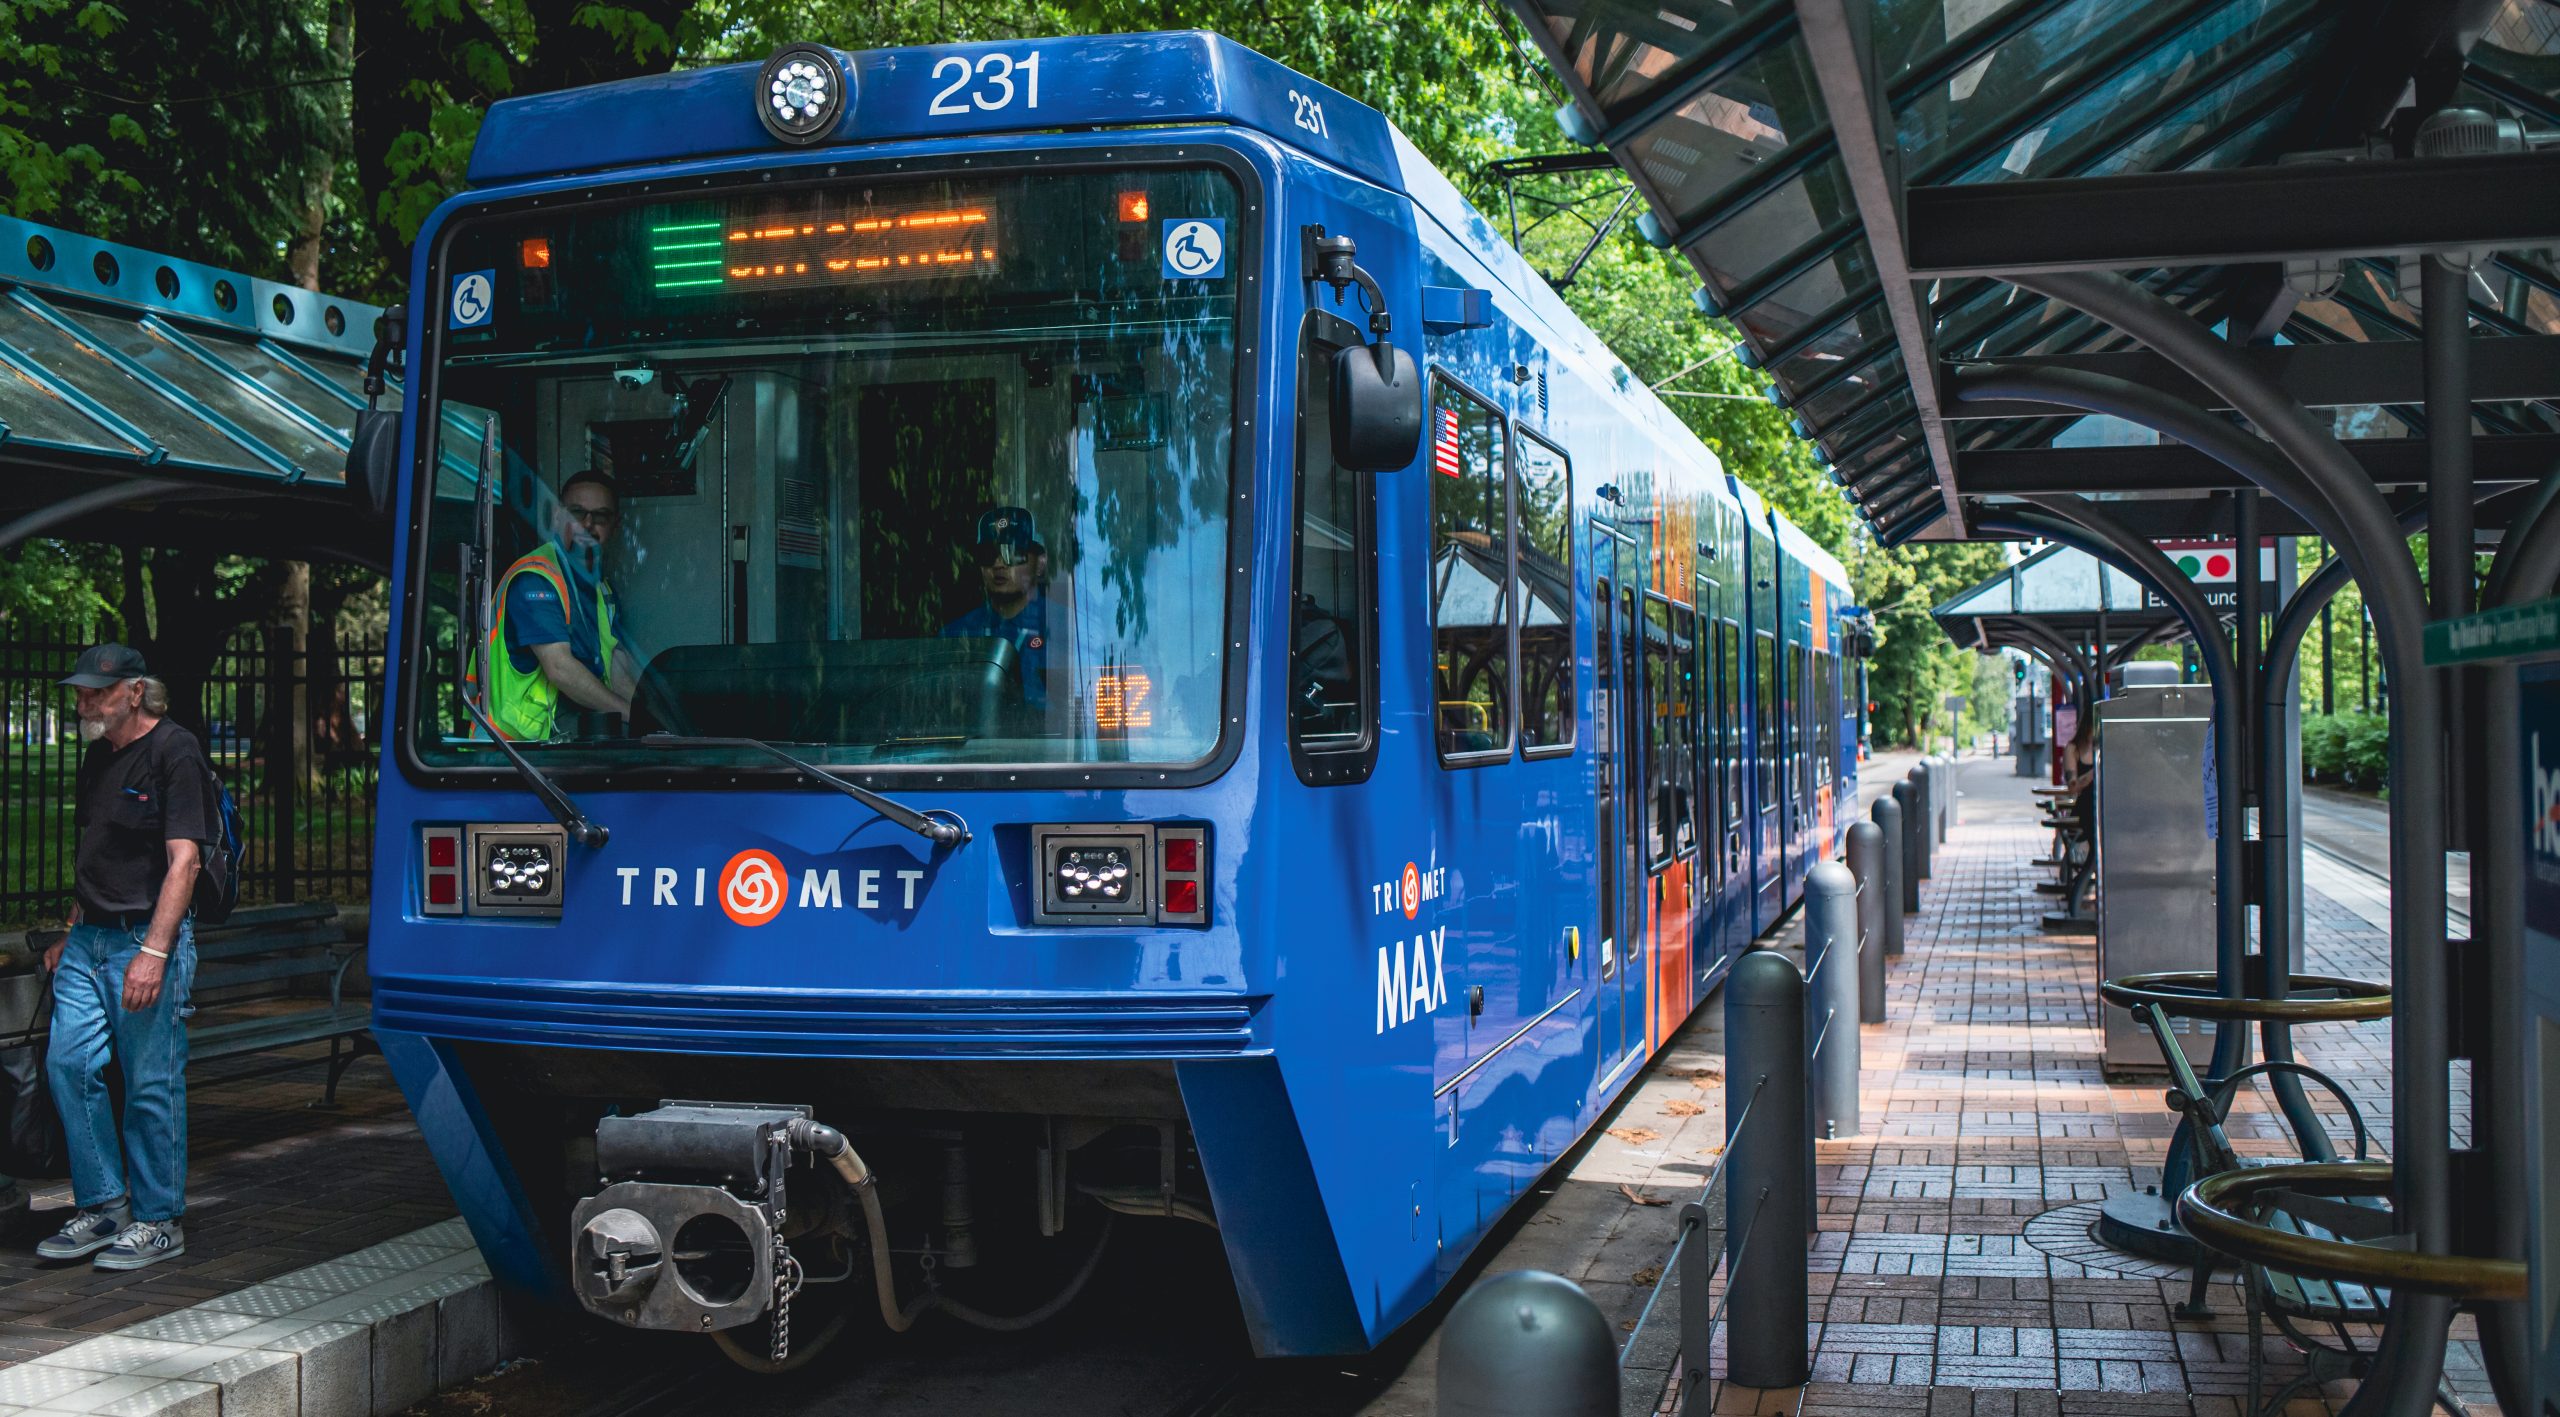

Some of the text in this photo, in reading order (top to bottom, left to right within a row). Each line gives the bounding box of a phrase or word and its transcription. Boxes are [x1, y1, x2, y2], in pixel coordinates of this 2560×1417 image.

[929, 51, 1040, 115] 231
[1288, 89, 1329, 139] 231
[616, 867, 924, 909] TRI MET
[1372, 866, 1446, 916] TRI MET
[1376, 925, 1448, 1036] MAX
